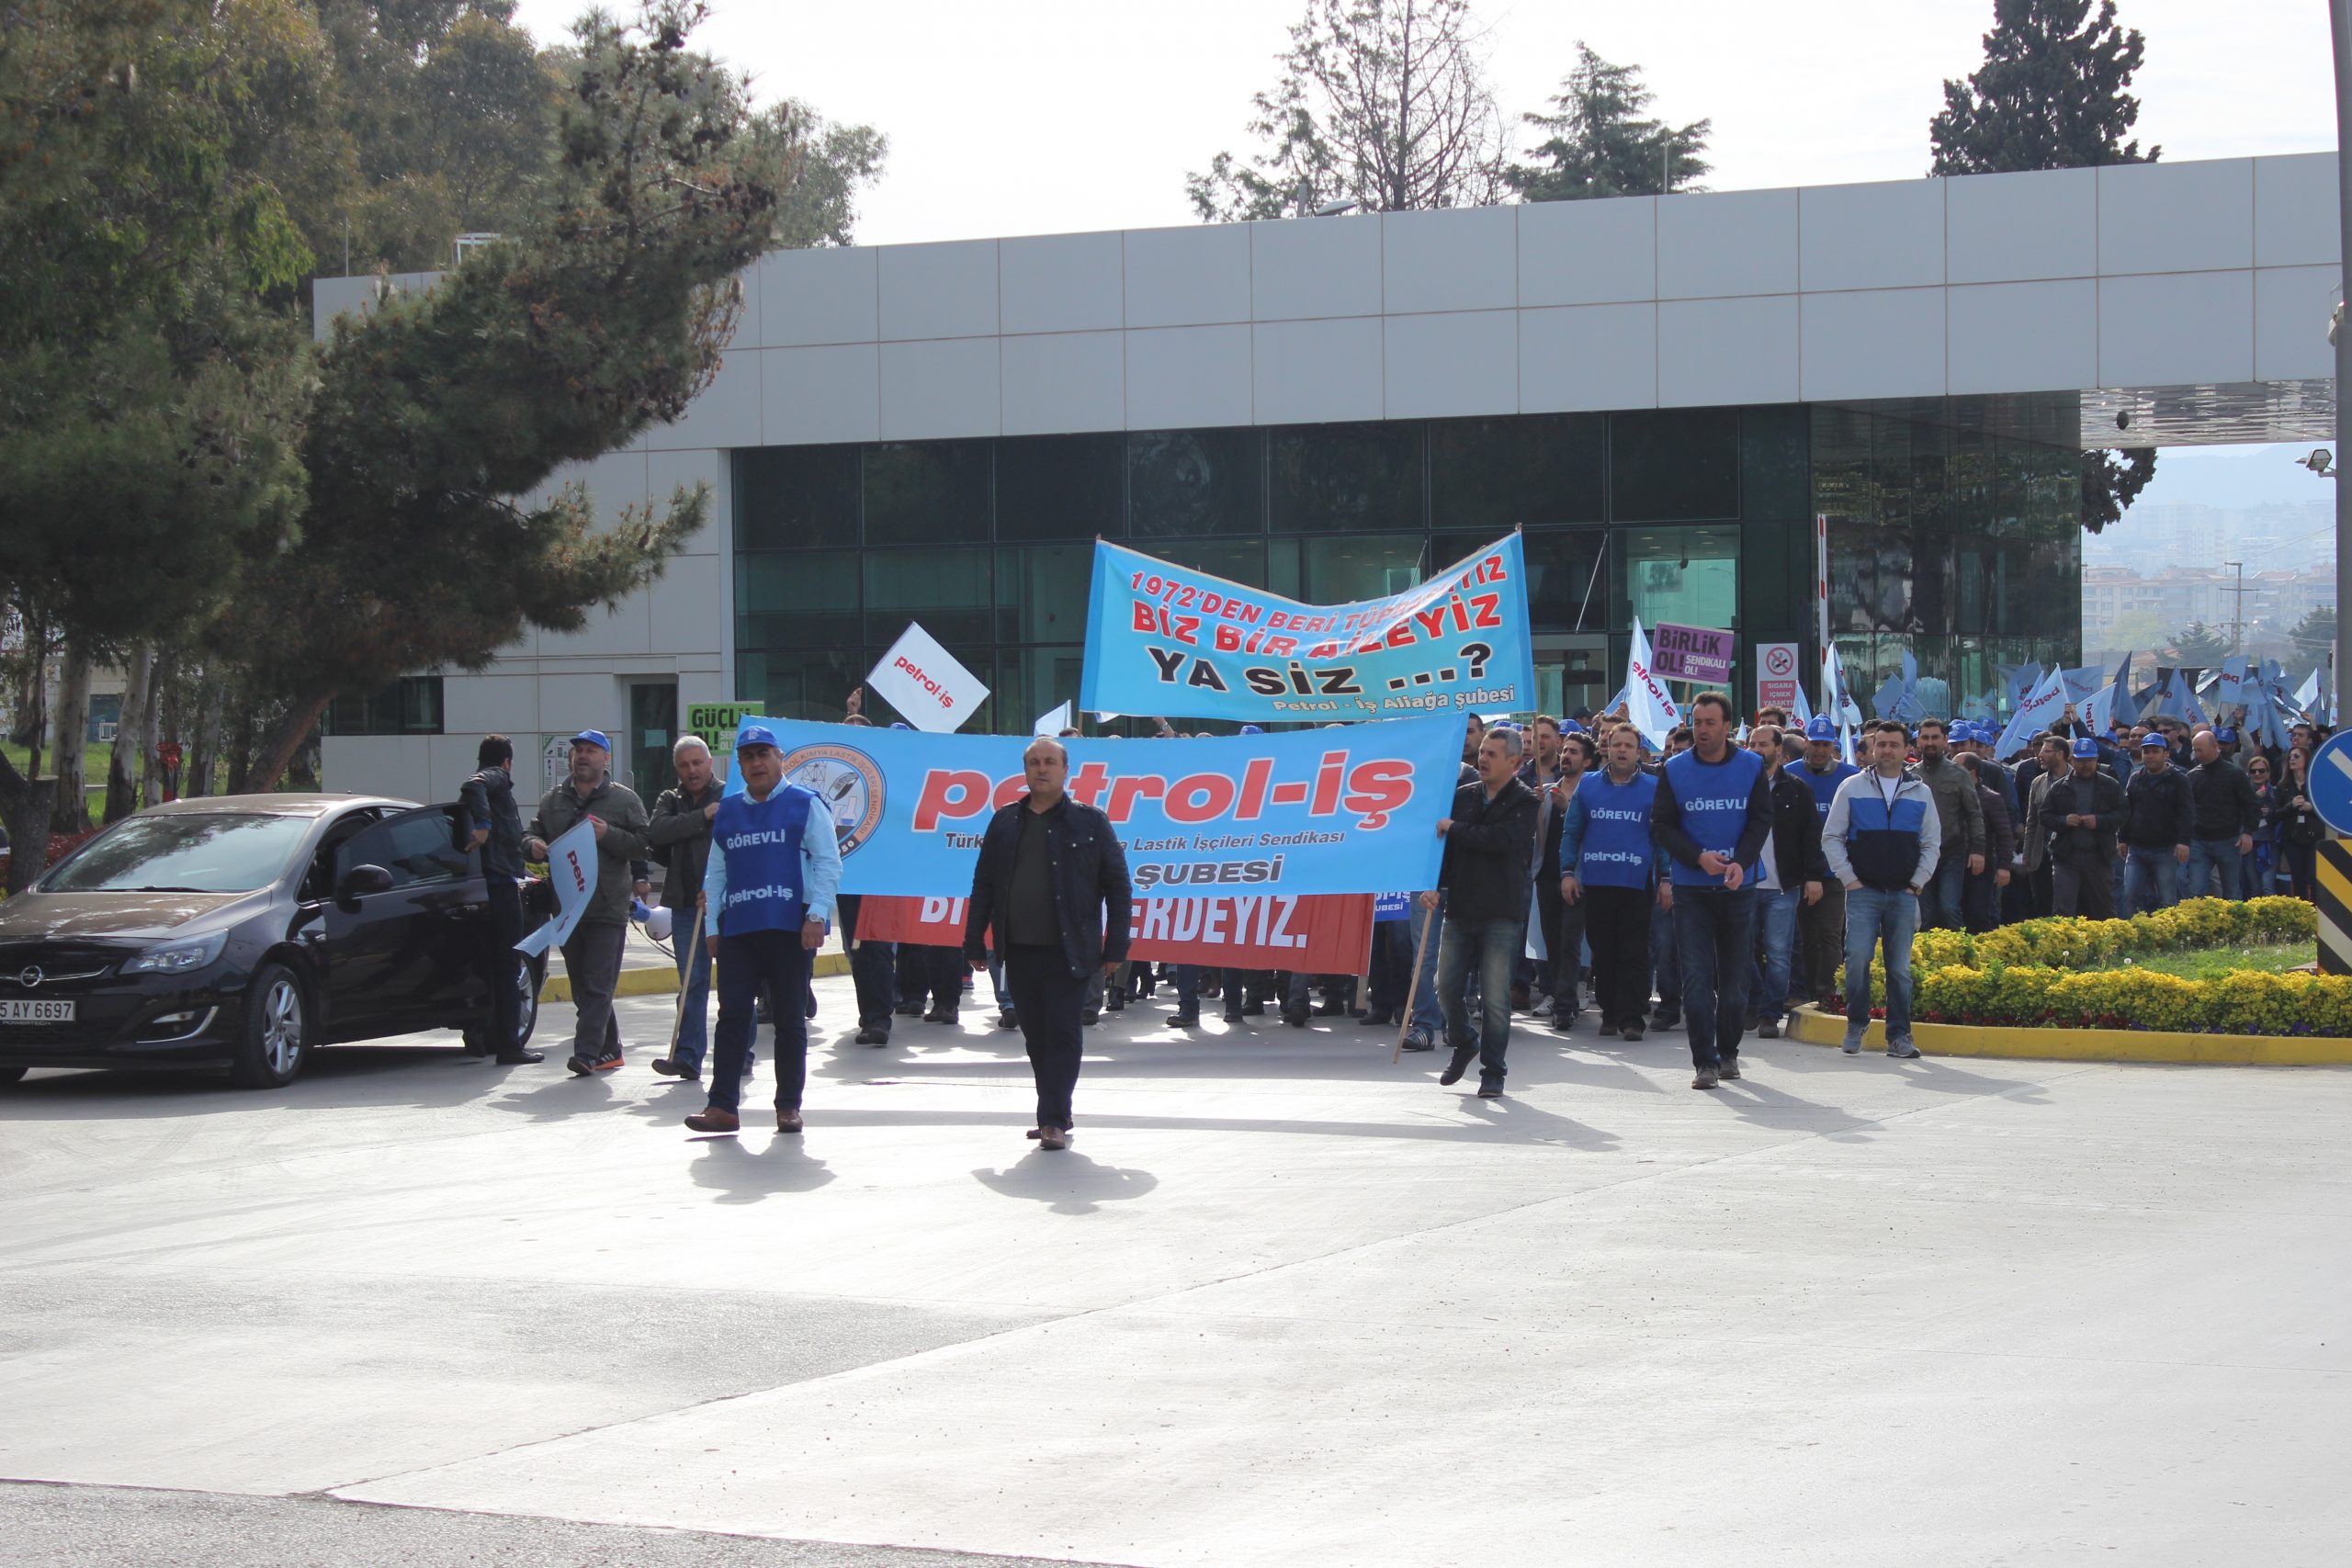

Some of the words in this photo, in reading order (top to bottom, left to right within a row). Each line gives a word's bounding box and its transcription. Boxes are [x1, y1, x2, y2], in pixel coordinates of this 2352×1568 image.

[1132, 571, 1262, 624] 1972'DEN
[1266, 610, 1338, 634] BERİ
[1134, 600, 1200, 646] BİZ
[1215, 624, 1298, 658] BİR
[1307, 593, 1501, 660] AİLEYİZ
[1658, 628, 1722, 656] BİRLİK
[1147, 646, 1227, 692] YA
[1244, 660, 1363, 696] SİZ
[1656, 650, 1685, 673] OL!
[1684, 665, 1699, 676] OL!
[1686, 654, 1726, 670] SENDİKALI
[894, 655, 955, 709] petrol-iş
[1632, 660, 1677, 718] etrol-iş
[1272, 700, 1340, 712] Petrol
[1354, 696, 1378, 714] İş
[1384, 691, 1450, 712] Aliağa
[1454, 684, 1516, 711] şubesi
[912, 749, 1416, 831] petrol-iş
[1590, 807, 1643, 823] GÖREVLİ
[1685, 797, 1747, 812] GÖREVLİ
[727, 829, 786, 850] GÖREVLİ
[945, 832, 986, 848] Türk
[1133, 837, 1188, 852] Lastik
[1193, 833, 1255, 853] İşçileri
[1259, 830, 1345, 847] Sendikası
[1584, 851, 1643, 866] petrol-iş
[1134, 854, 1285, 890] ŞUBESİ
[729, 885, 794, 908] petrol-iş
[1375, 902, 1404, 911] UBESİ
[13, 1002, 30, 1018] AY
[35, 1002, 72, 1019] 6697
